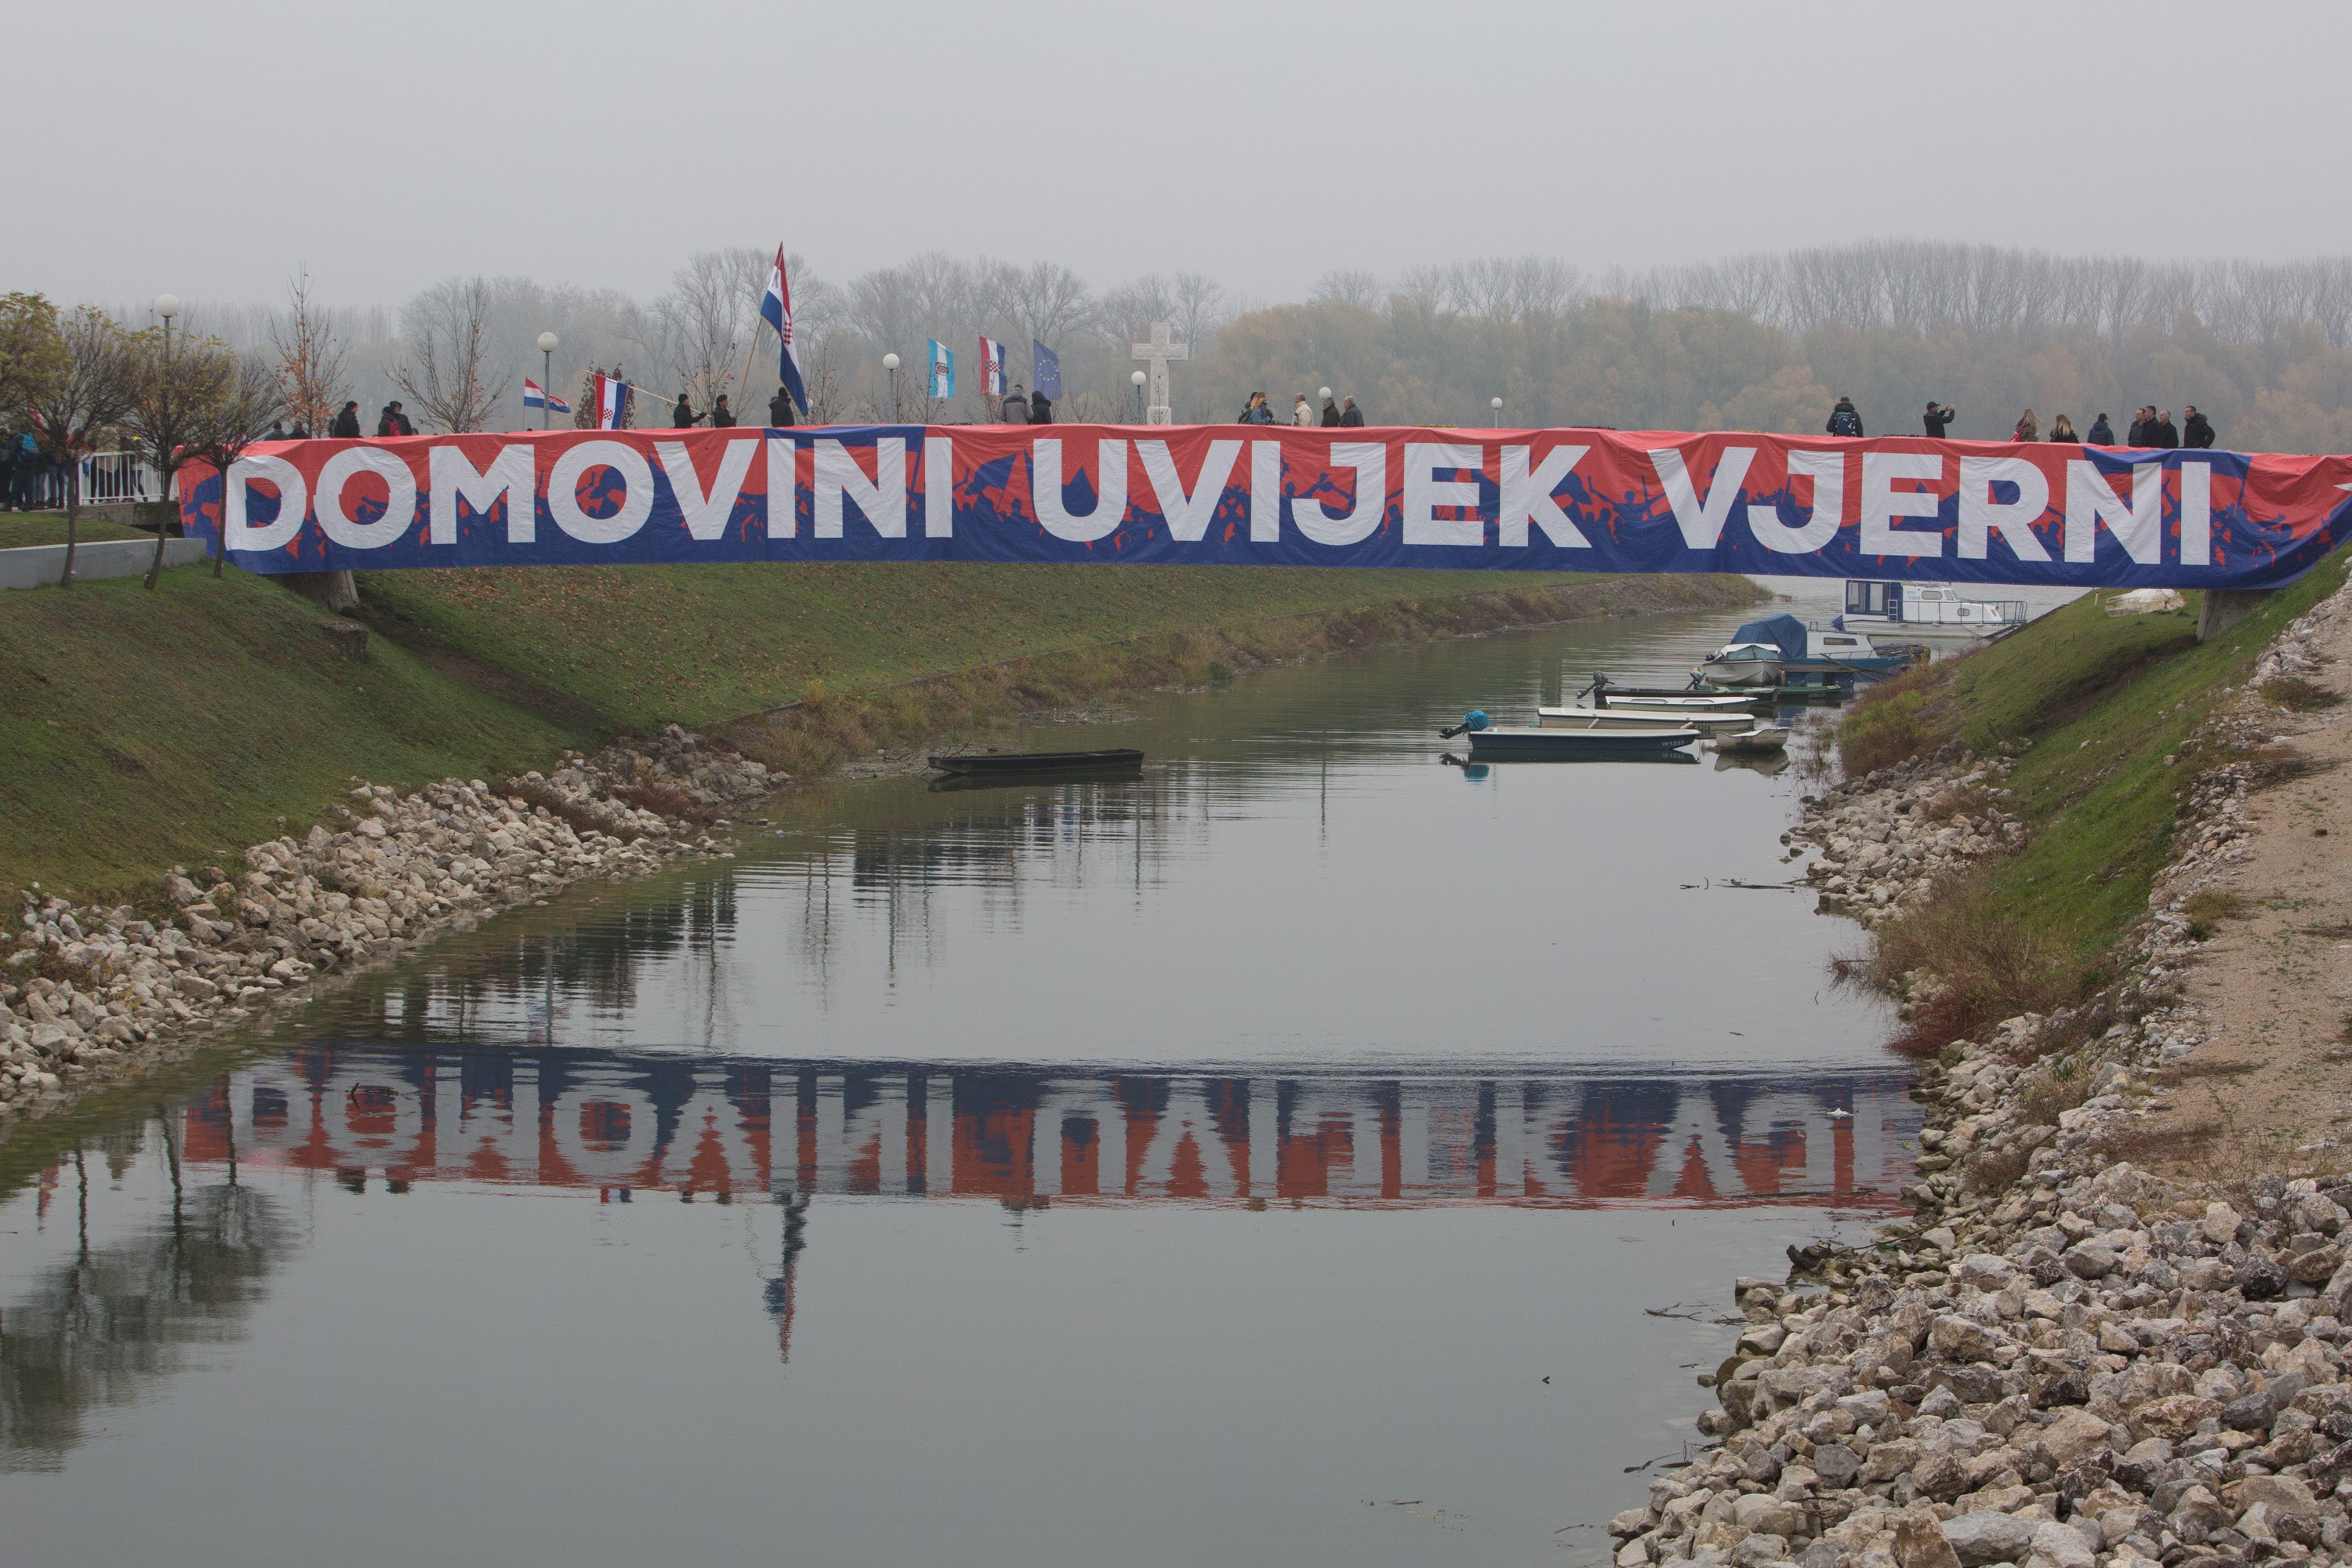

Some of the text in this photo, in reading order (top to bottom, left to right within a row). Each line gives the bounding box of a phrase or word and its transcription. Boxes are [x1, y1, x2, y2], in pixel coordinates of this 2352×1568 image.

[225, 437, 2212, 566] DOMOVINI UVIJEK VJERNI
